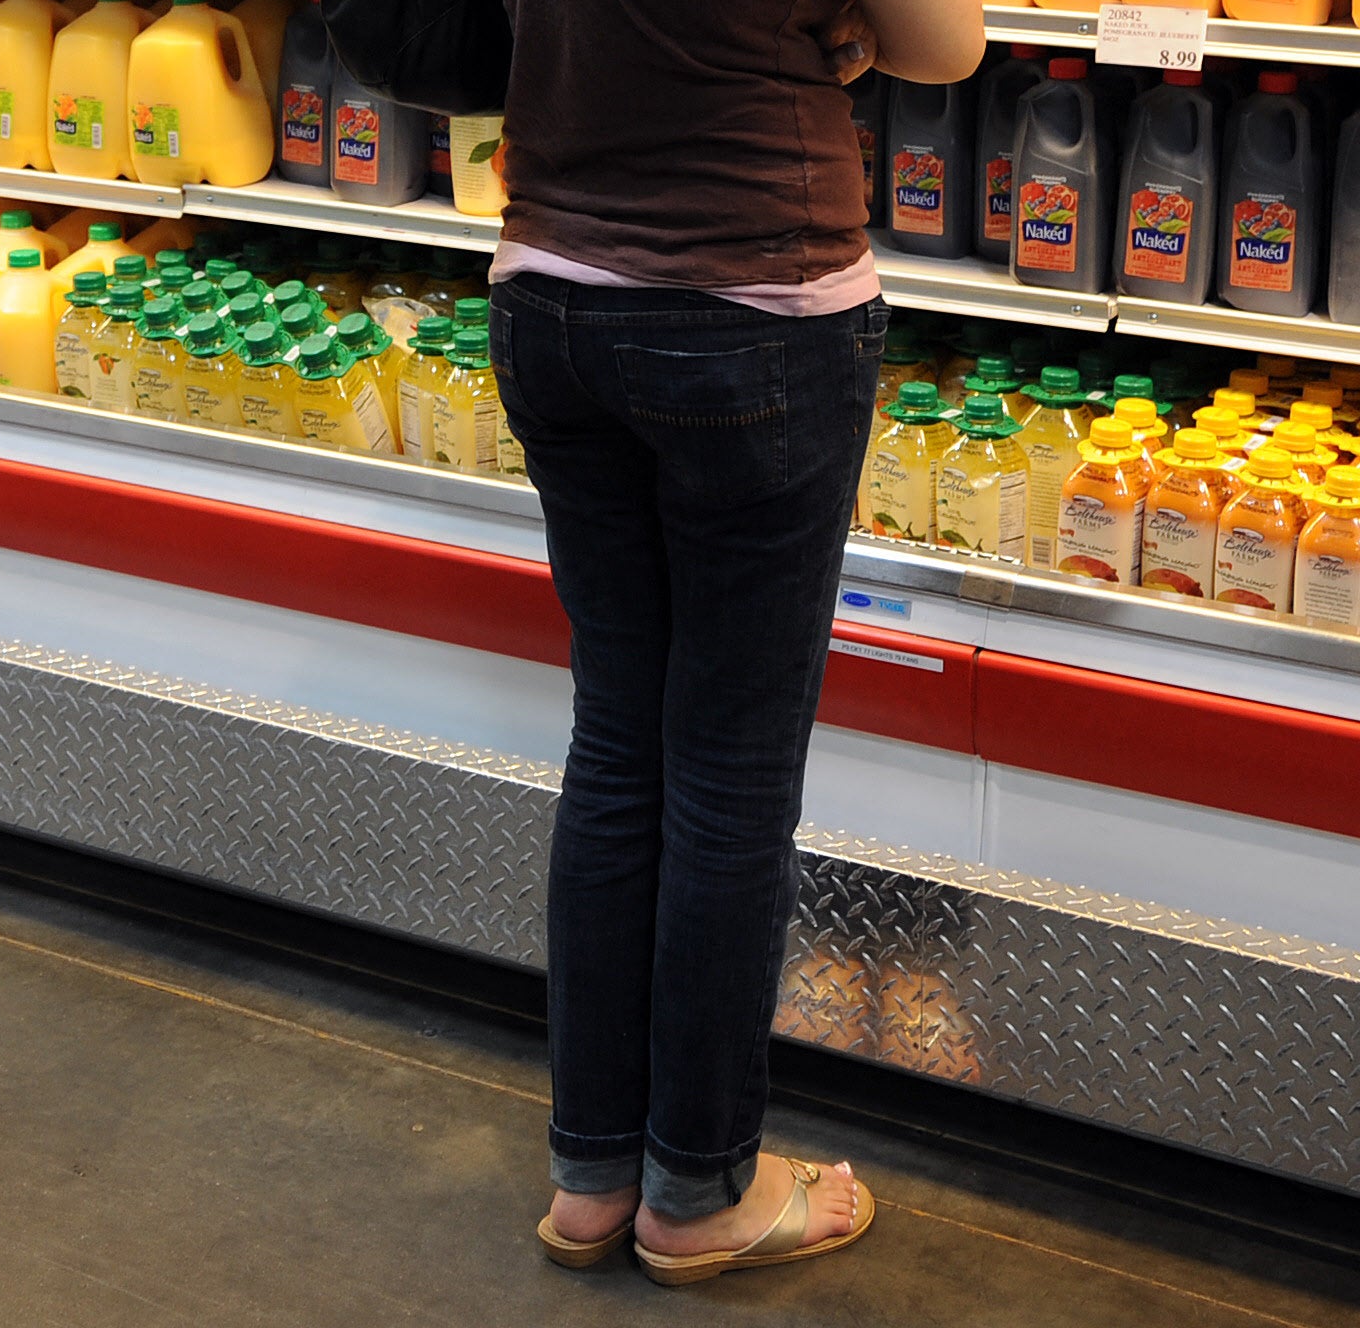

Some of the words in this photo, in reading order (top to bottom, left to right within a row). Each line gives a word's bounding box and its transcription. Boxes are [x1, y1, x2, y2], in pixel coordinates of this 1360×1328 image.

[1108, 9, 1142, 21] 20842
[1159, 50, 1196, 67] 8.99
[340, 142, 371, 158] Naked
[899, 191, 935, 206] Naked
[1026, 224, 1067, 241] Naked
[1136, 232, 1179, 251] Naked
[1240, 243, 1284, 261] Naked
